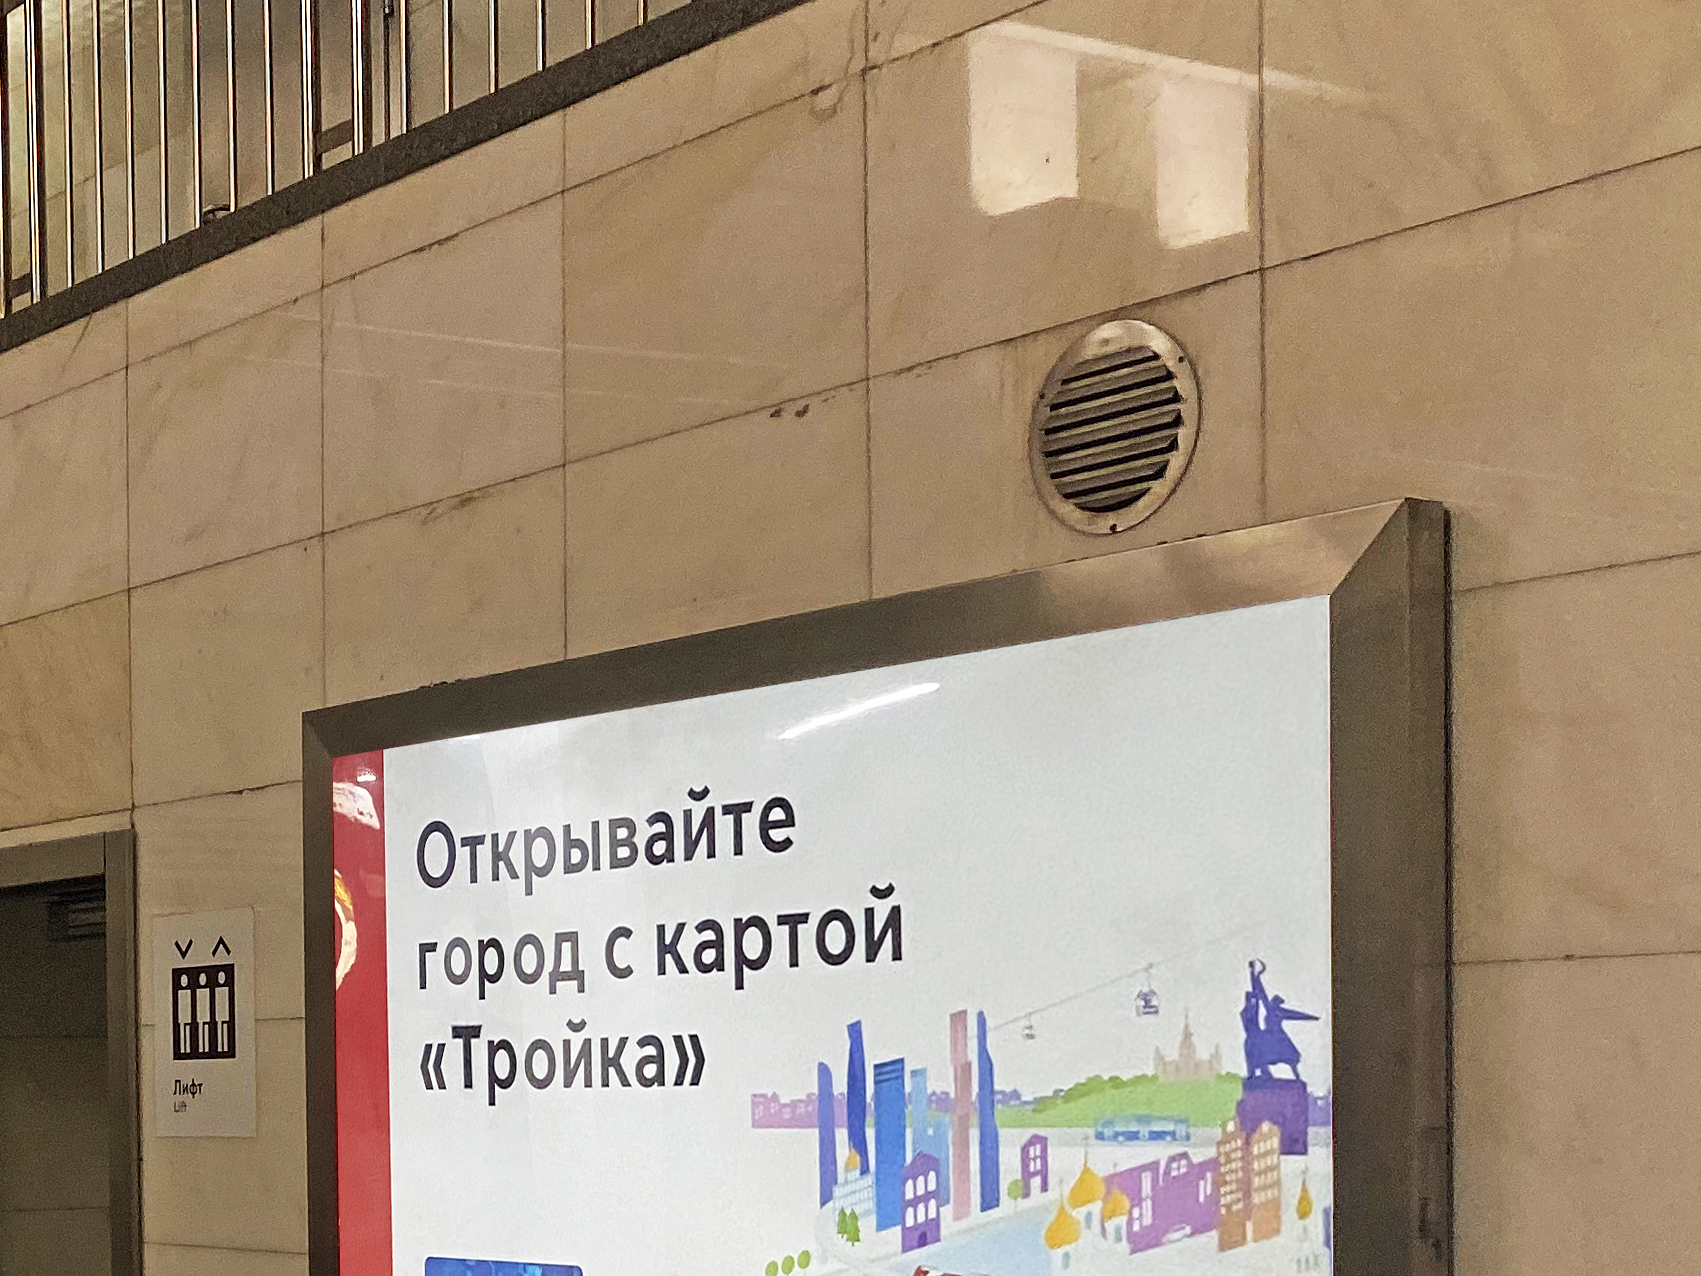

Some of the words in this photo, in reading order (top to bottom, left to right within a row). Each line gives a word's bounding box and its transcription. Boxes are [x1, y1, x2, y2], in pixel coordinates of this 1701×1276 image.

[416, 785, 796, 896] Открывайте
[417, 931, 585, 1000] город
[604, 925, 634, 979] с
[656, 881, 903, 991] картой
[172, 1077, 203, 1099] Лифт
[172, 1101, 188, 1113] Lift
[419, 1018, 707, 1107] «Тройка»
